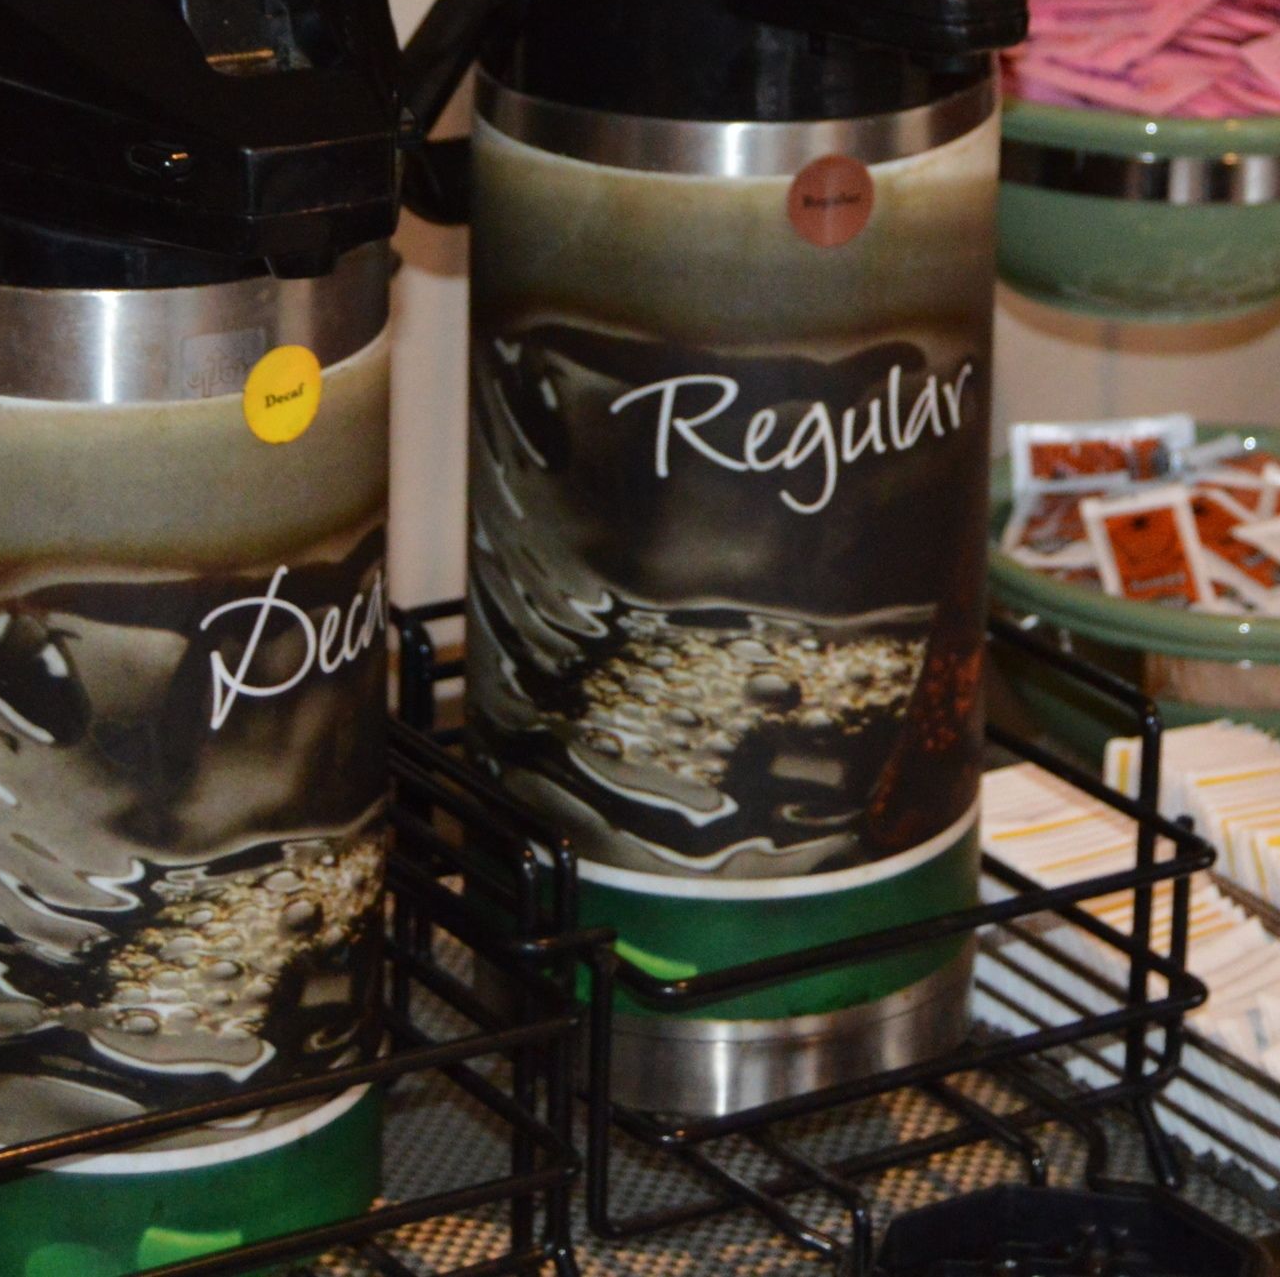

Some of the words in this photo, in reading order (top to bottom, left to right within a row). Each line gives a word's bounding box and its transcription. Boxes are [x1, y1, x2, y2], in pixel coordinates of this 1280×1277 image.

[264, 381, 305, 410] Decaf
[609, 362, 973, 514] Regular
[200, 565, 386, 729] Deca
